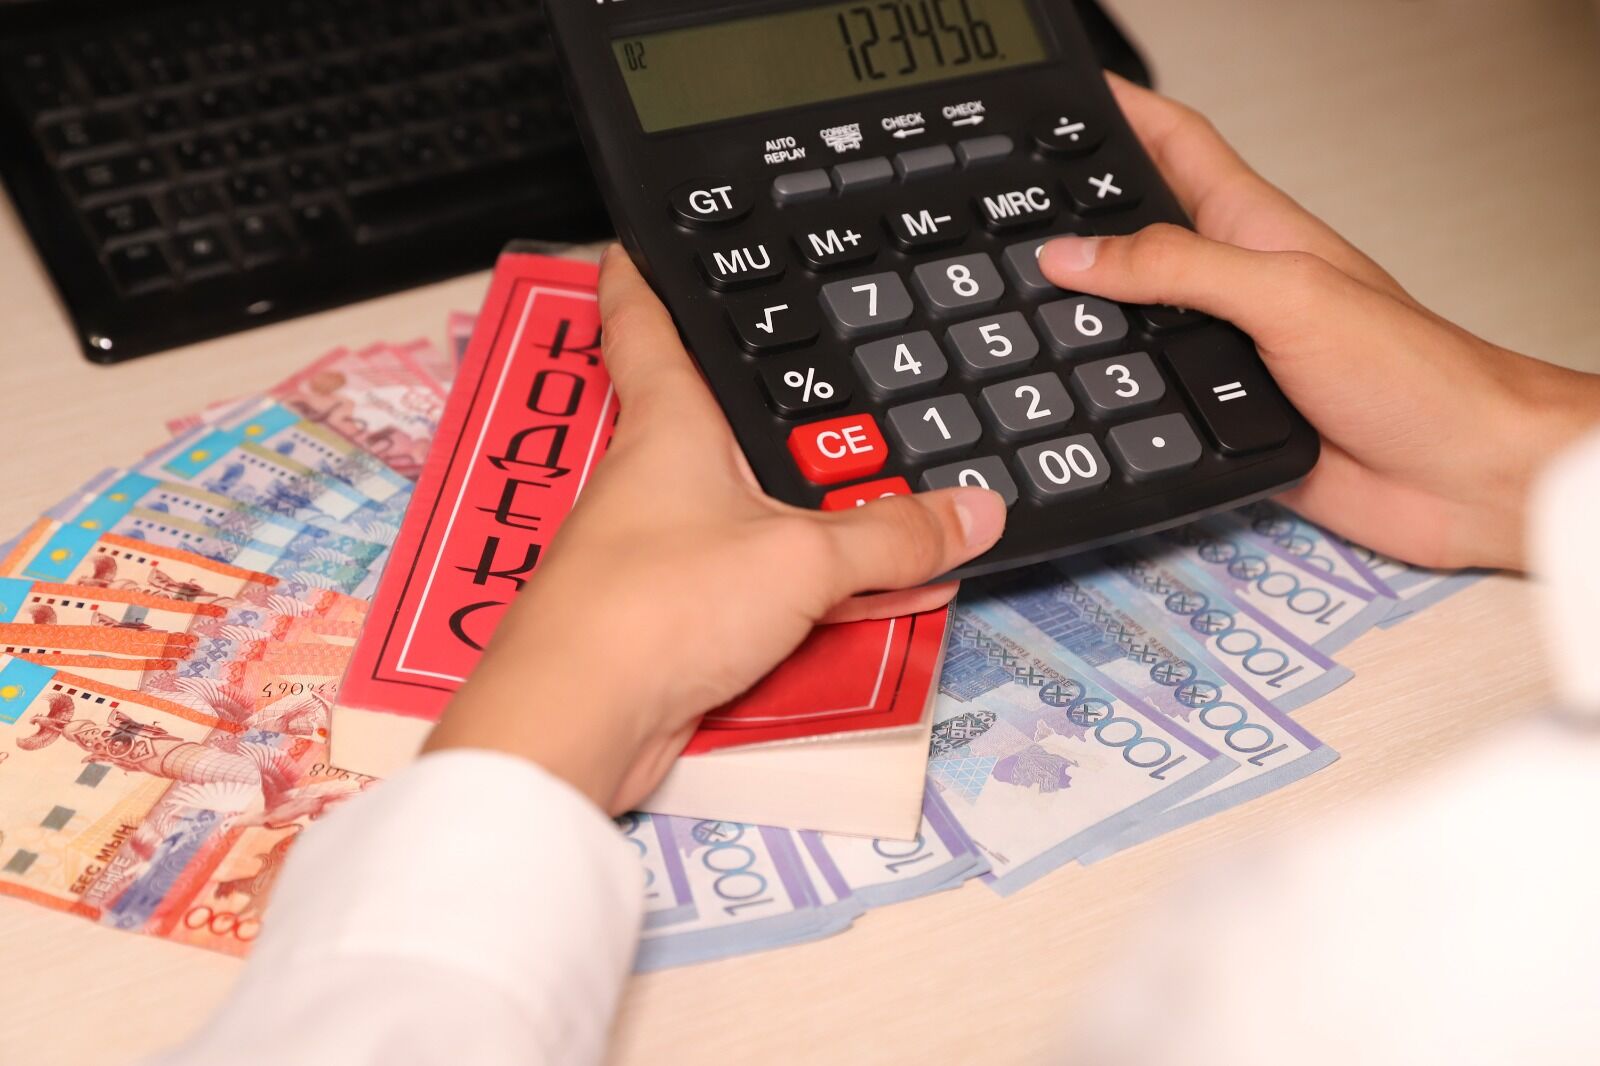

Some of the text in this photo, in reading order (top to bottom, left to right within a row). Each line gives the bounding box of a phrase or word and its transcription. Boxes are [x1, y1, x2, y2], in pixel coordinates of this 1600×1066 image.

[623, 41, 647, 71] 02
[881, 112, 926, 131] CHECK
[942, 101, 986, 120] CHECK
[765, 136, 797, 151] AUTO
[819, 123, 861, 138] CORRECT
[763, 148, 806, 164] REPLAY
[688, 185, 733, 214] GT
[983, 186, 1051, 220] MRC
[712, 244, 771, 275] MU
[807, 229, 862, 257] M+
[945, 263, 980, 297] 8
[851, 283, 878, 316] 7
[1073, 303, 1103, 337] 6
[978, 323, 1013, 357] 5
[892, 343, 922, 375] 4
[783, 367, 834, 402] %
[1105, 364, 1140, 398] 3
[1014, 385, 1052, 420] 2
[922, 407, 952, 440] 1
[816, 425, 874, 458] CE
[1037, 443, 1098, 485] 00
[449, 319, 602, 652] КОДЕКС
[1197, 538, 1347, 626] 10000
[1165, 590, 1305, 688] 10000
[1038, 679, 1188, 781] 10000
[1149, 660, 1290, 767] 10000
[69, 864, 102, 895] БЕС
